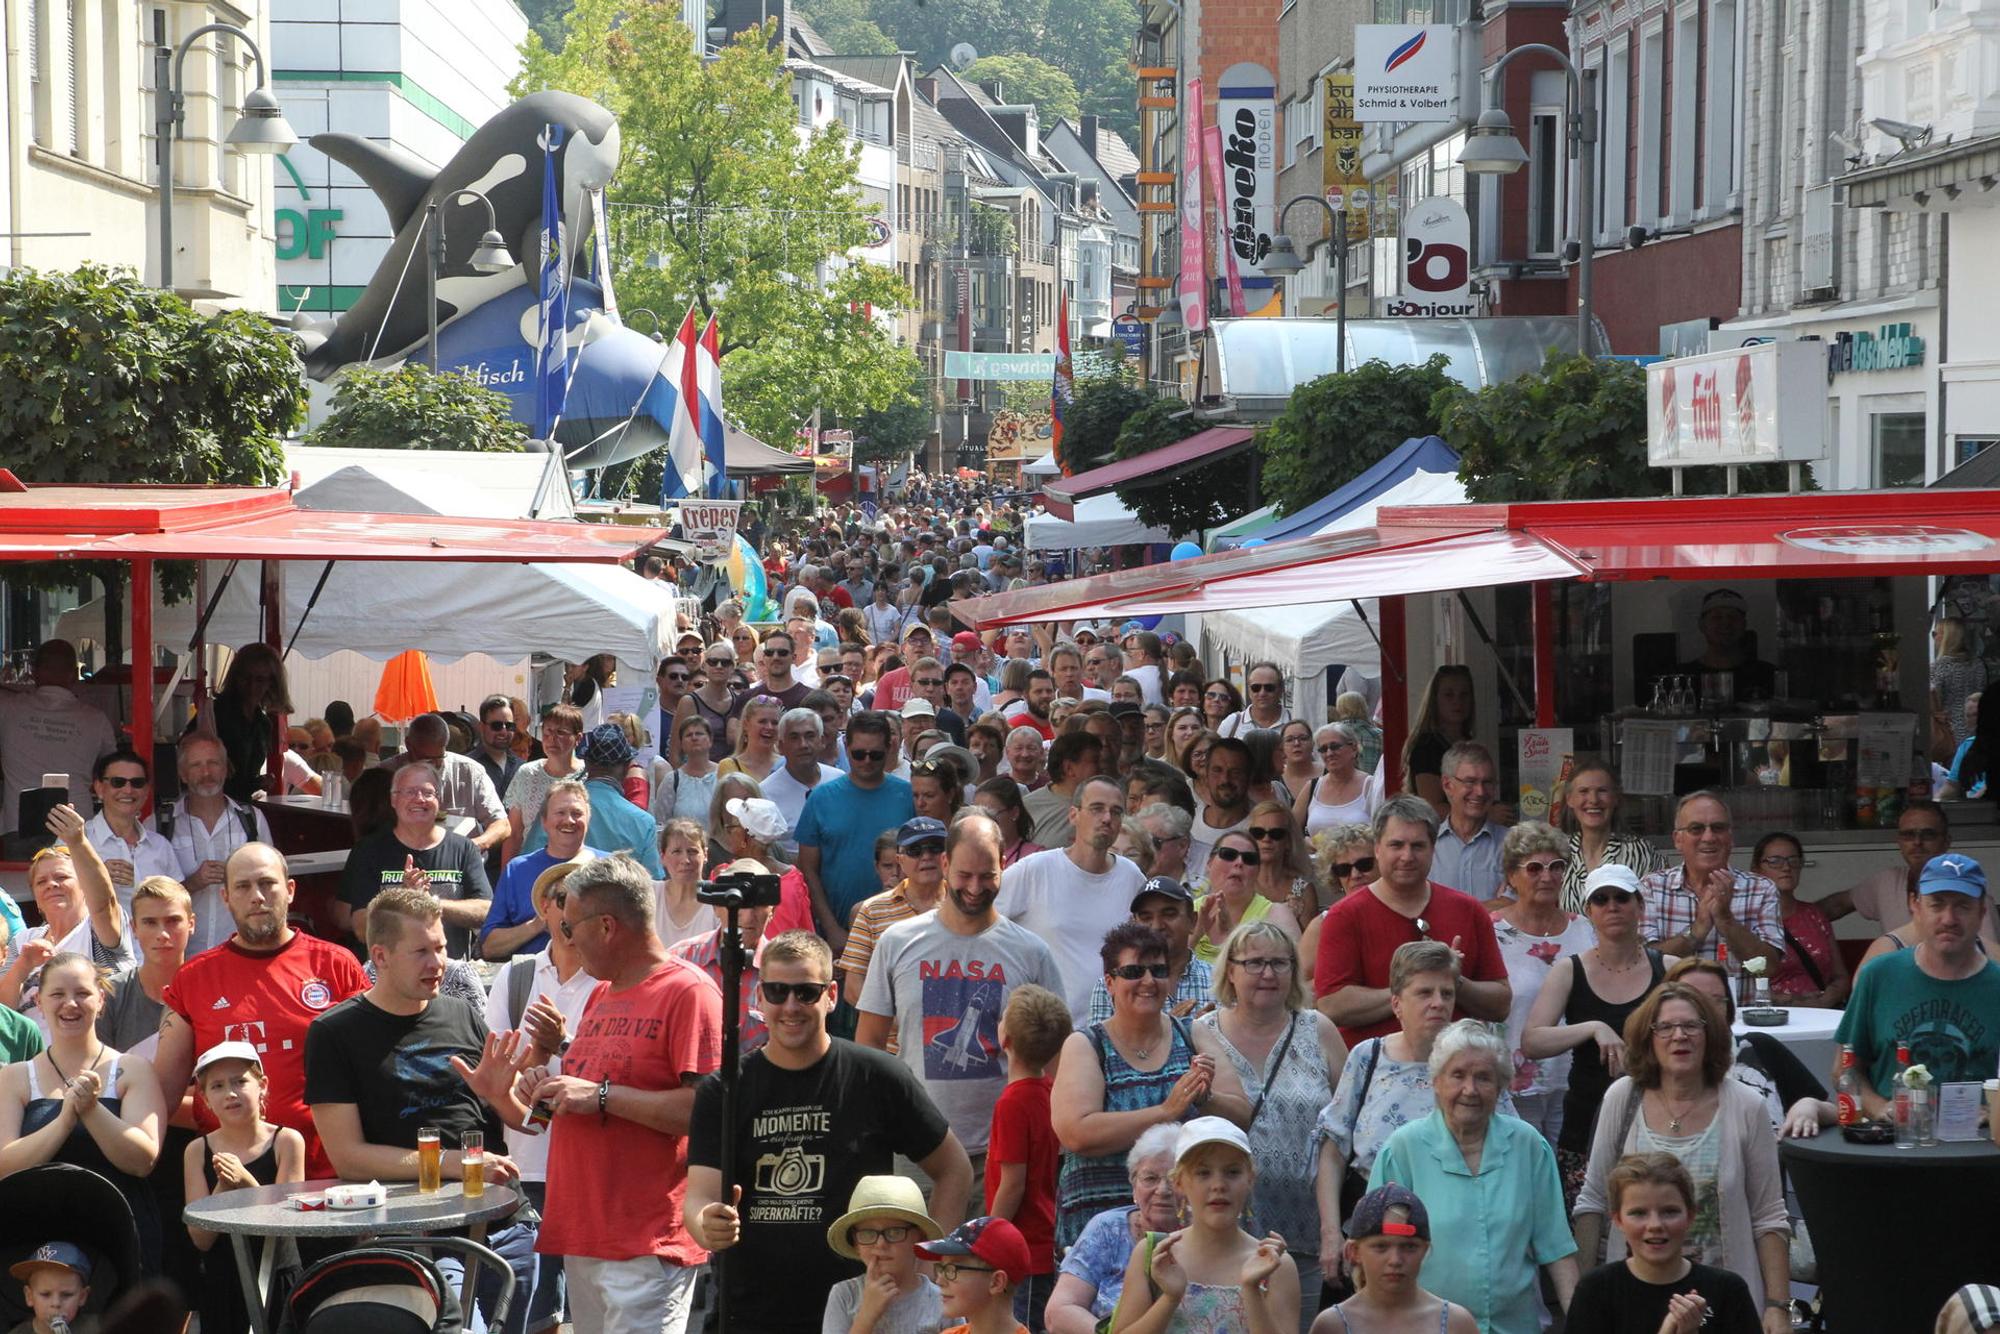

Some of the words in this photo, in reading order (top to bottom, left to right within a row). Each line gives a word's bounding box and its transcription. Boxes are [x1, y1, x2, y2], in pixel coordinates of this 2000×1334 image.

[1367, 85, 1439, 94] PHYSIOTHERAPIE
[1359, 99, 1397, 108] Schmid
[1400, 99, 1406, 108] &
[1410, 99, 1447, 108] Volbert
[1328, 120, 1363, 139] bar
[682, 506, 738, 530] Crêpes
[919, 959, 1007, 985] NASA
[604, 1017, 663, 1039] DRIVE
[753, 1112, 831, 1138] MOMENTE
[749, 1204, 823, 1221] SUPERKRÄFTE?
